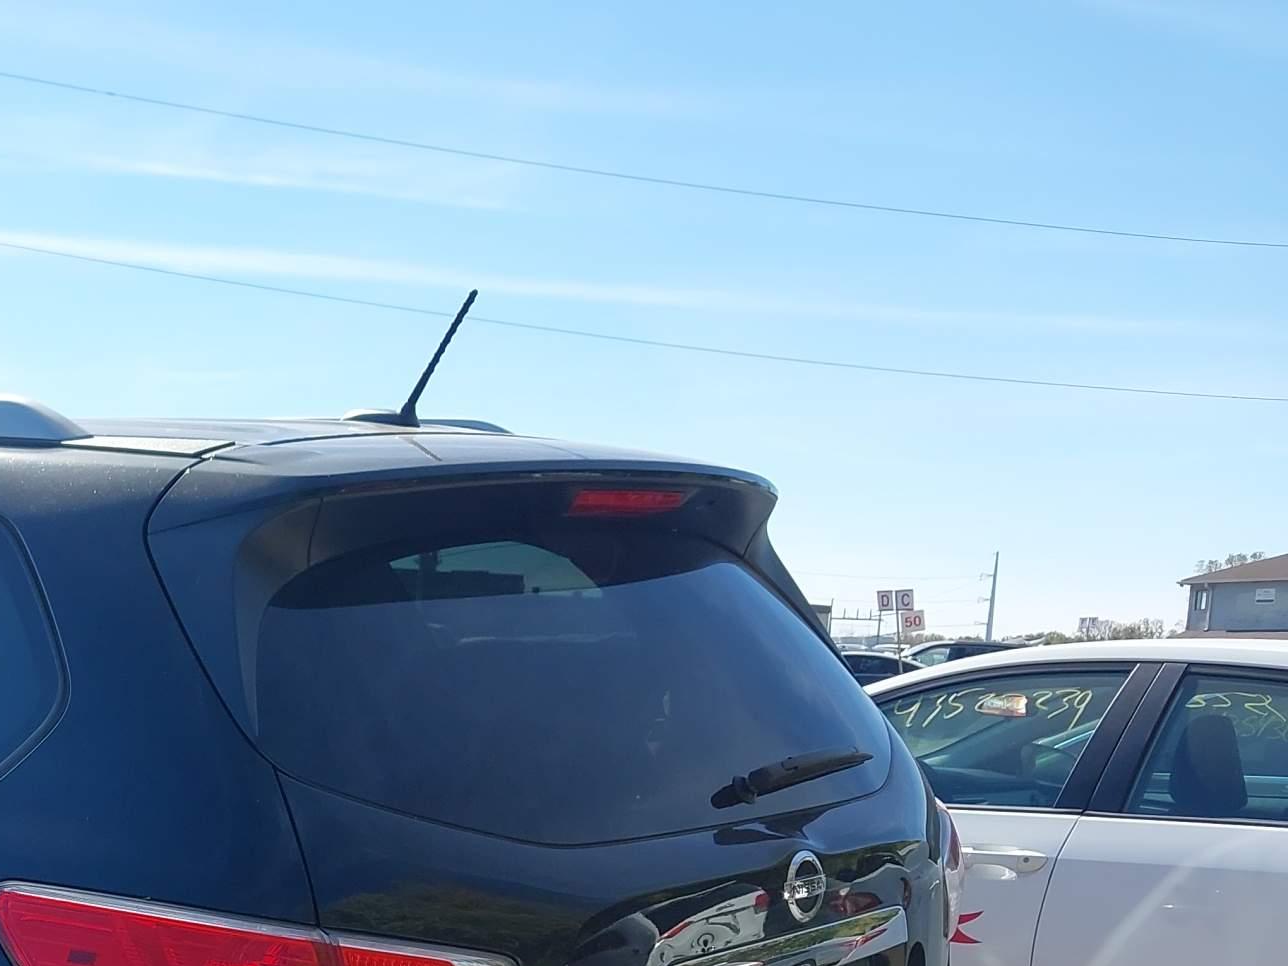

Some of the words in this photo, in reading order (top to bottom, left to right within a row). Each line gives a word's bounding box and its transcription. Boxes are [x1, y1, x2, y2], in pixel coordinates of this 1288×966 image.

[880, 594, 890, 608] D
[901, 593, 910, 607] C
[904, 615, 922, 628] 50
